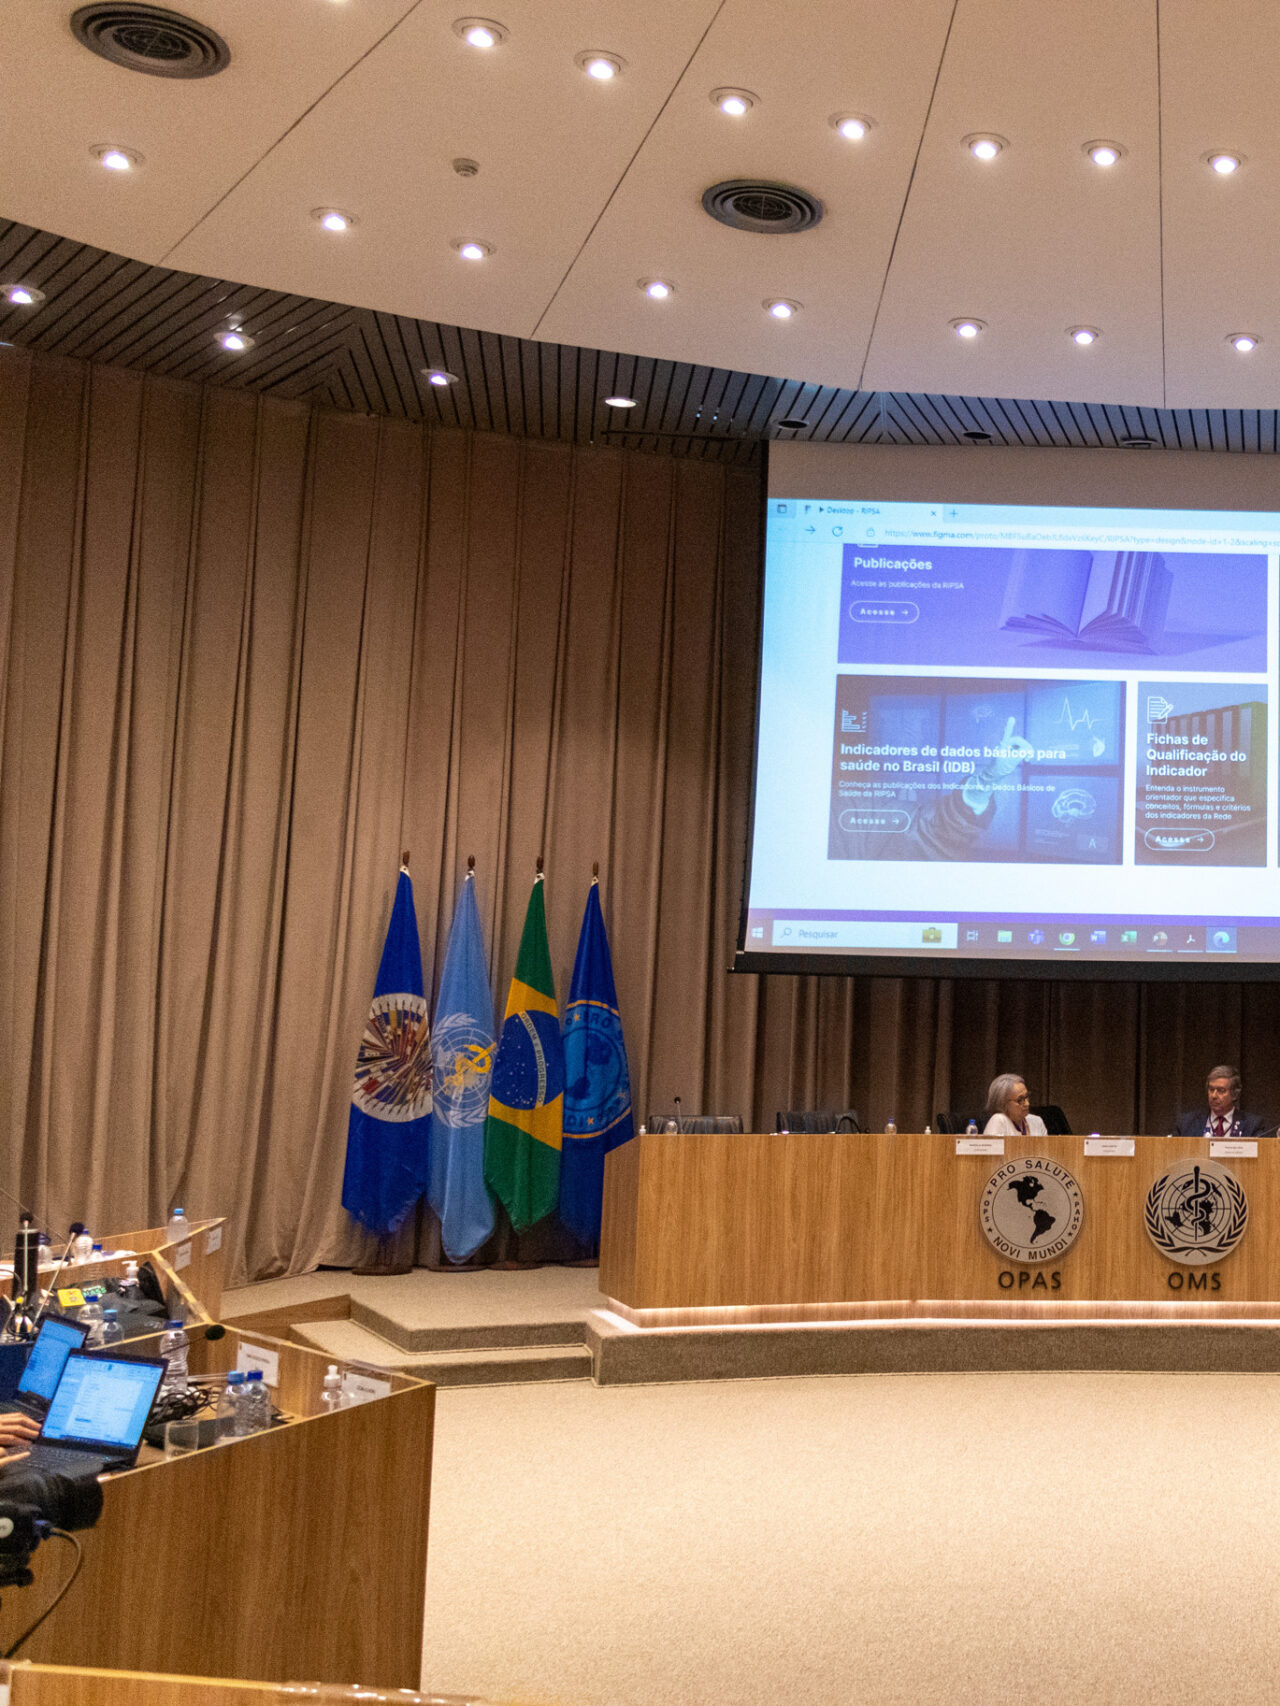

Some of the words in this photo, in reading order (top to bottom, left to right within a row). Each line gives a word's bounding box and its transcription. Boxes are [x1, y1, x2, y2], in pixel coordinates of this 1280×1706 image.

[853, 556, 933, 572] Publicações
[851, 579, 877, 588] Acesse
[888, 580, 931, 590] publicações
[942, 582, 965, 590] RIPSA
[860, 608, 896, 616] Acesse
[1146, 733, 1189, 746] Fichas
[1192, 734, 1208, 746] de
[840, 744, 918, 756] Indicadores
[921, 745, 937, 756] de
[940, 746, 981, 758] dados
[984, 746, 1034, 758] básicos
[1037, 750, 1066, 761] para
[1146, 749, 1227, 764] Qualificação
[1230, 750, 1247, 762] do
[840, 760, 880, 772] saúde
[883, 762, 899, 772] no
[903, 760, 940, 772] Brasil
[943, 760, 976, 774] (IDB)
[1146, 764, 1208, 777] Indicador
[838, 780, 871, 789] Conheça
[883, 781, 926, 790] publicações
[928, 782, 940, 790] dos
[1016, 784, 1044, 792] Básicos
[1046, 784, 1056, 792] de
[1146, 784, 1175, 792] Entenda
[1183, 785, 1225, 793] instrumento
[874, 790, 896, 798] RIPSA
[1146, 793, 1181, 801] orientador
[1184, 795, 1196, 803] que
[1145, 802, 1181, 810] conceitos,
[1184, 802, 1214, 811] fórmulas
[1222, 804, 1251, 812] critérios
[1145, 811, 1158, 819] dos
[1160, 812, 1200, 820] indicadores
[1203, 812, 1212, 820] da
[1214, 812, 1232, 820] Rede
[1155, 835, 1191, 844] Acesse
[799, 929, 838, 940] Pesquisar
[990, 1164, 1015, 1187] PRO
[1025, 1160, 1075, 1189] SALUTE
[1072, 1201, 1081, 1230] PAHO
[994, 1236, 1020, 1258] NOVI
[1028, 1238, 1068, 1260] MUNDI
[998, 1271, 1062, 1290] OPAS
[1168, 1272, 1221, 1290] OMS
